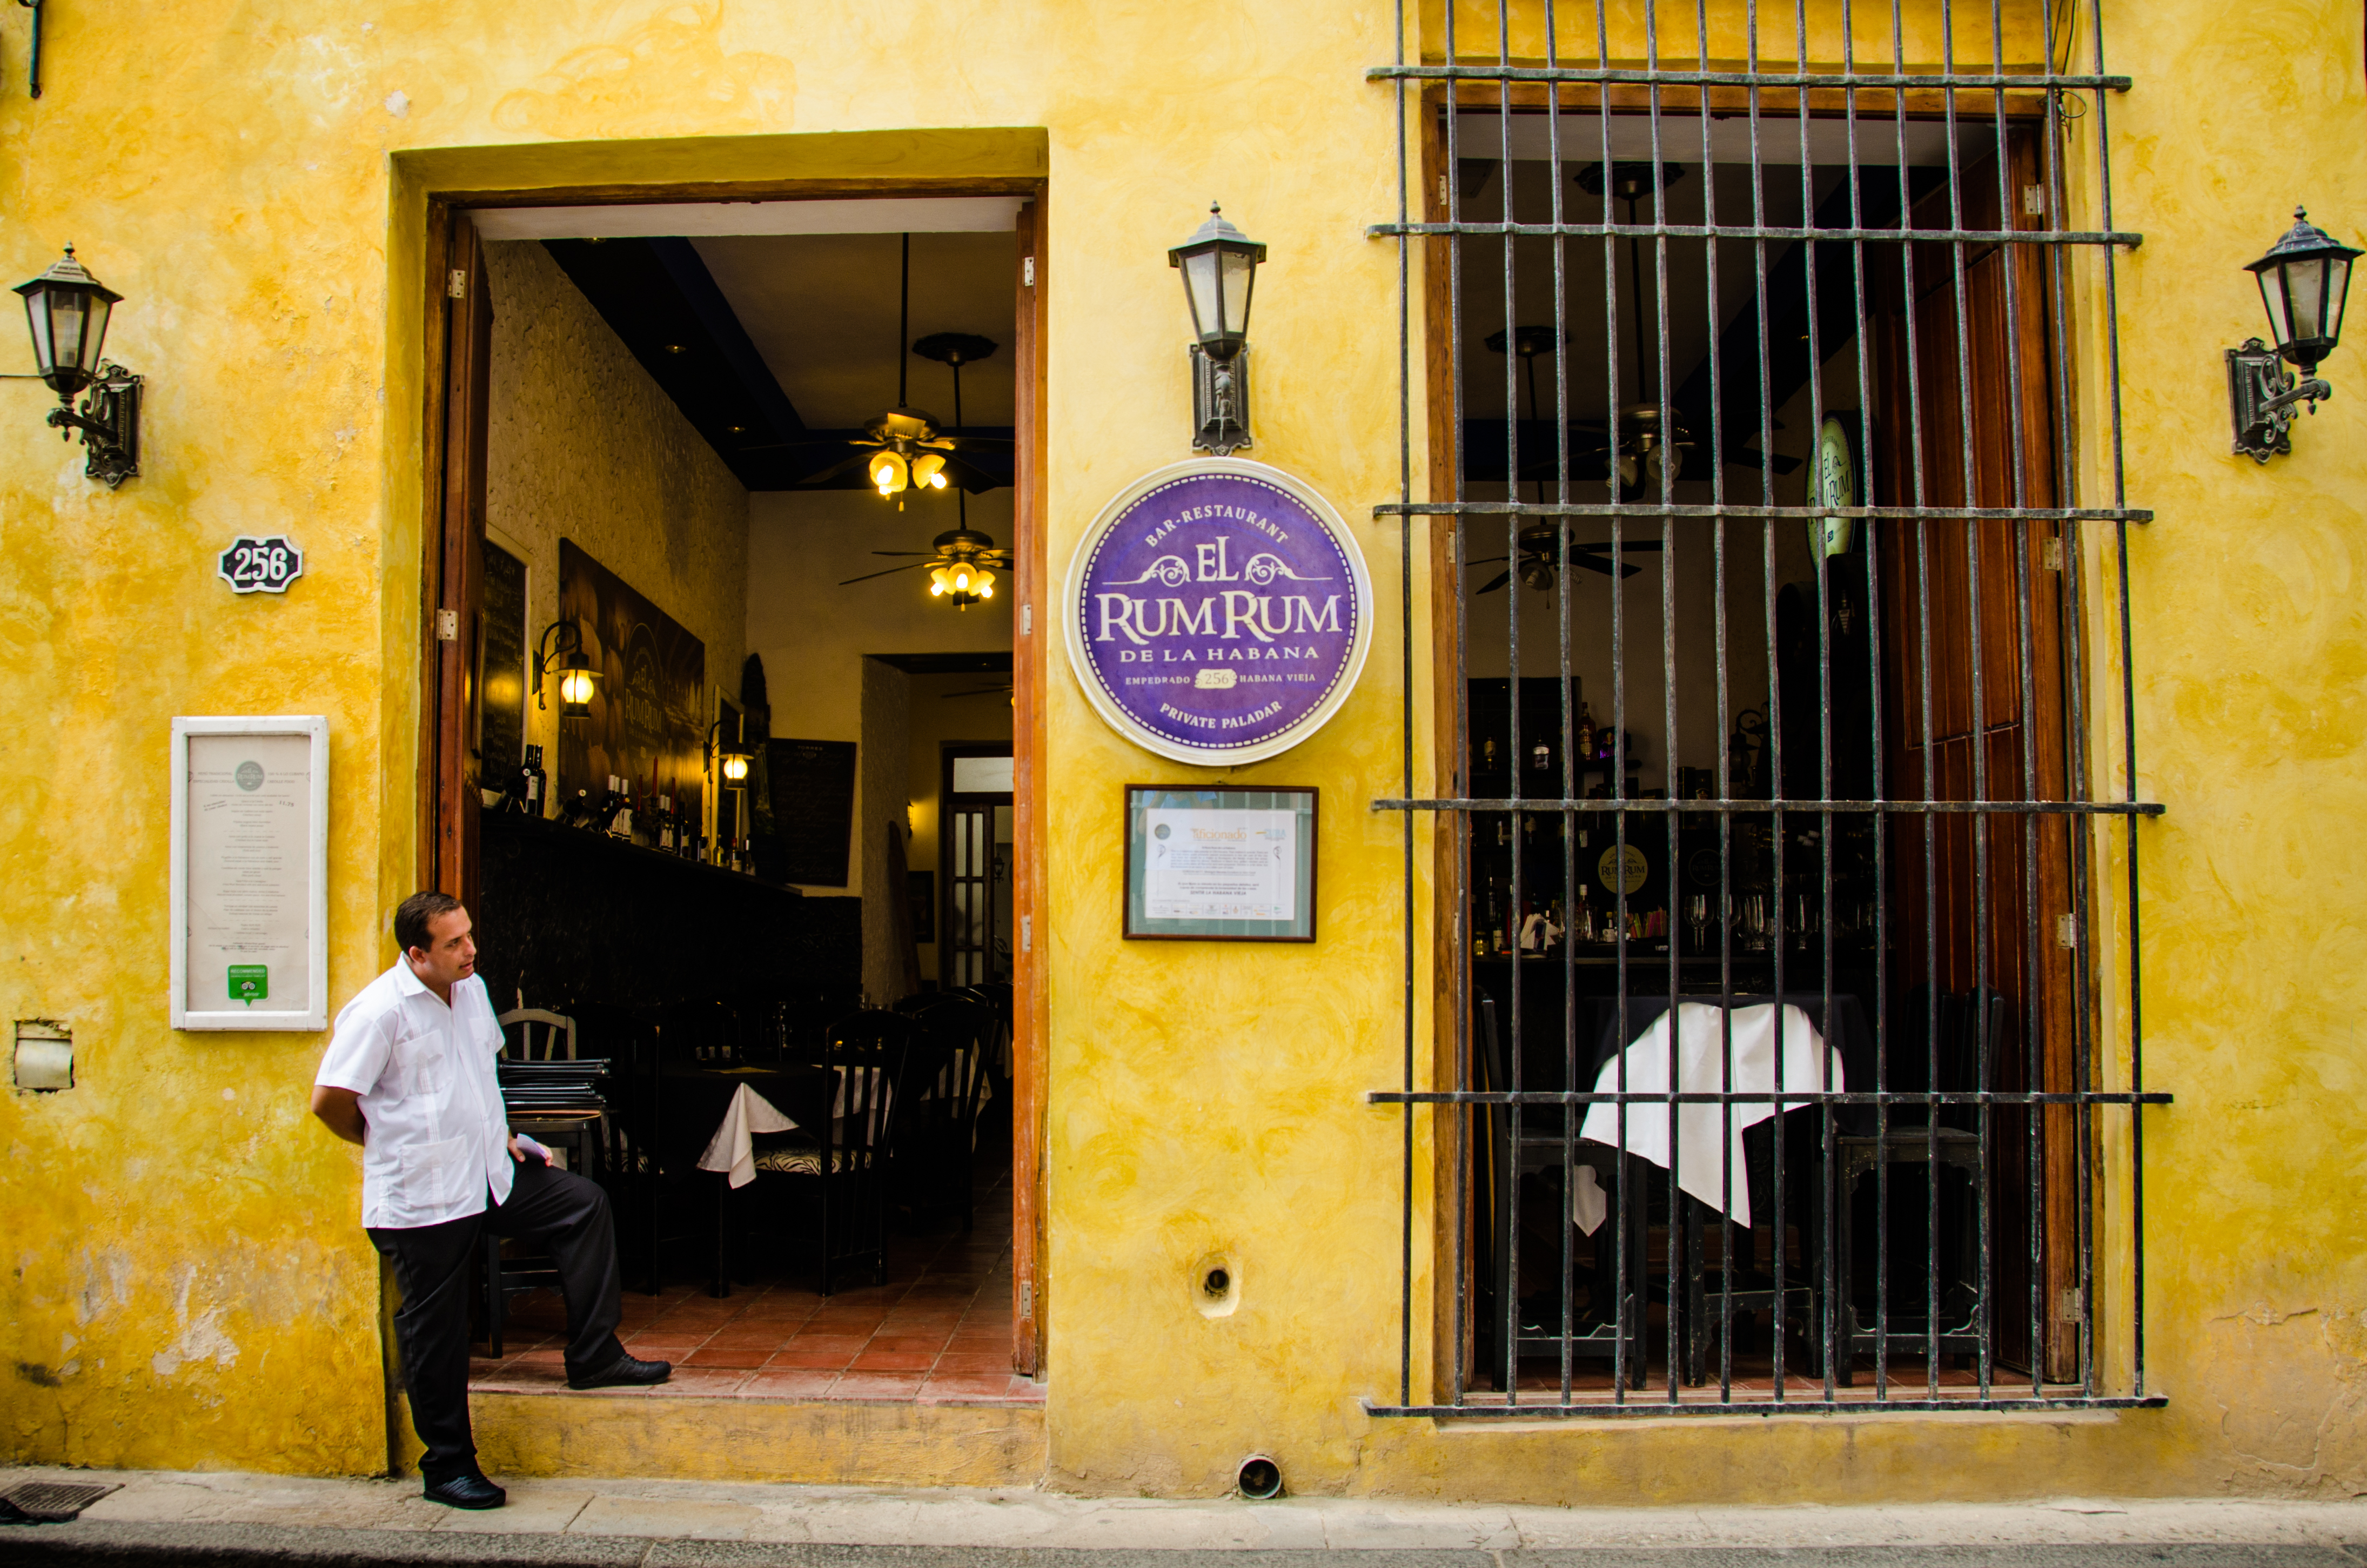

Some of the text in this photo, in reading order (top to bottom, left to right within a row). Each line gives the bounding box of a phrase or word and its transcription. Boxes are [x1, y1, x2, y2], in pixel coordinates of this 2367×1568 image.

[1824, 452, 1831, 480] EL
[1144, 504, 1289, 548] BAR-RESTAURANT
[234, 547, 287, 581] 256
[1196, 535, 1239, 582] EL
[1120, 646, 1319, 663] DE LA HABANA
[1125, 673, 1316, 685] EMPEDRADO 256 HABANA VIEJA
[1159, 700, 1283, 729] PRIVATE PALADAR
